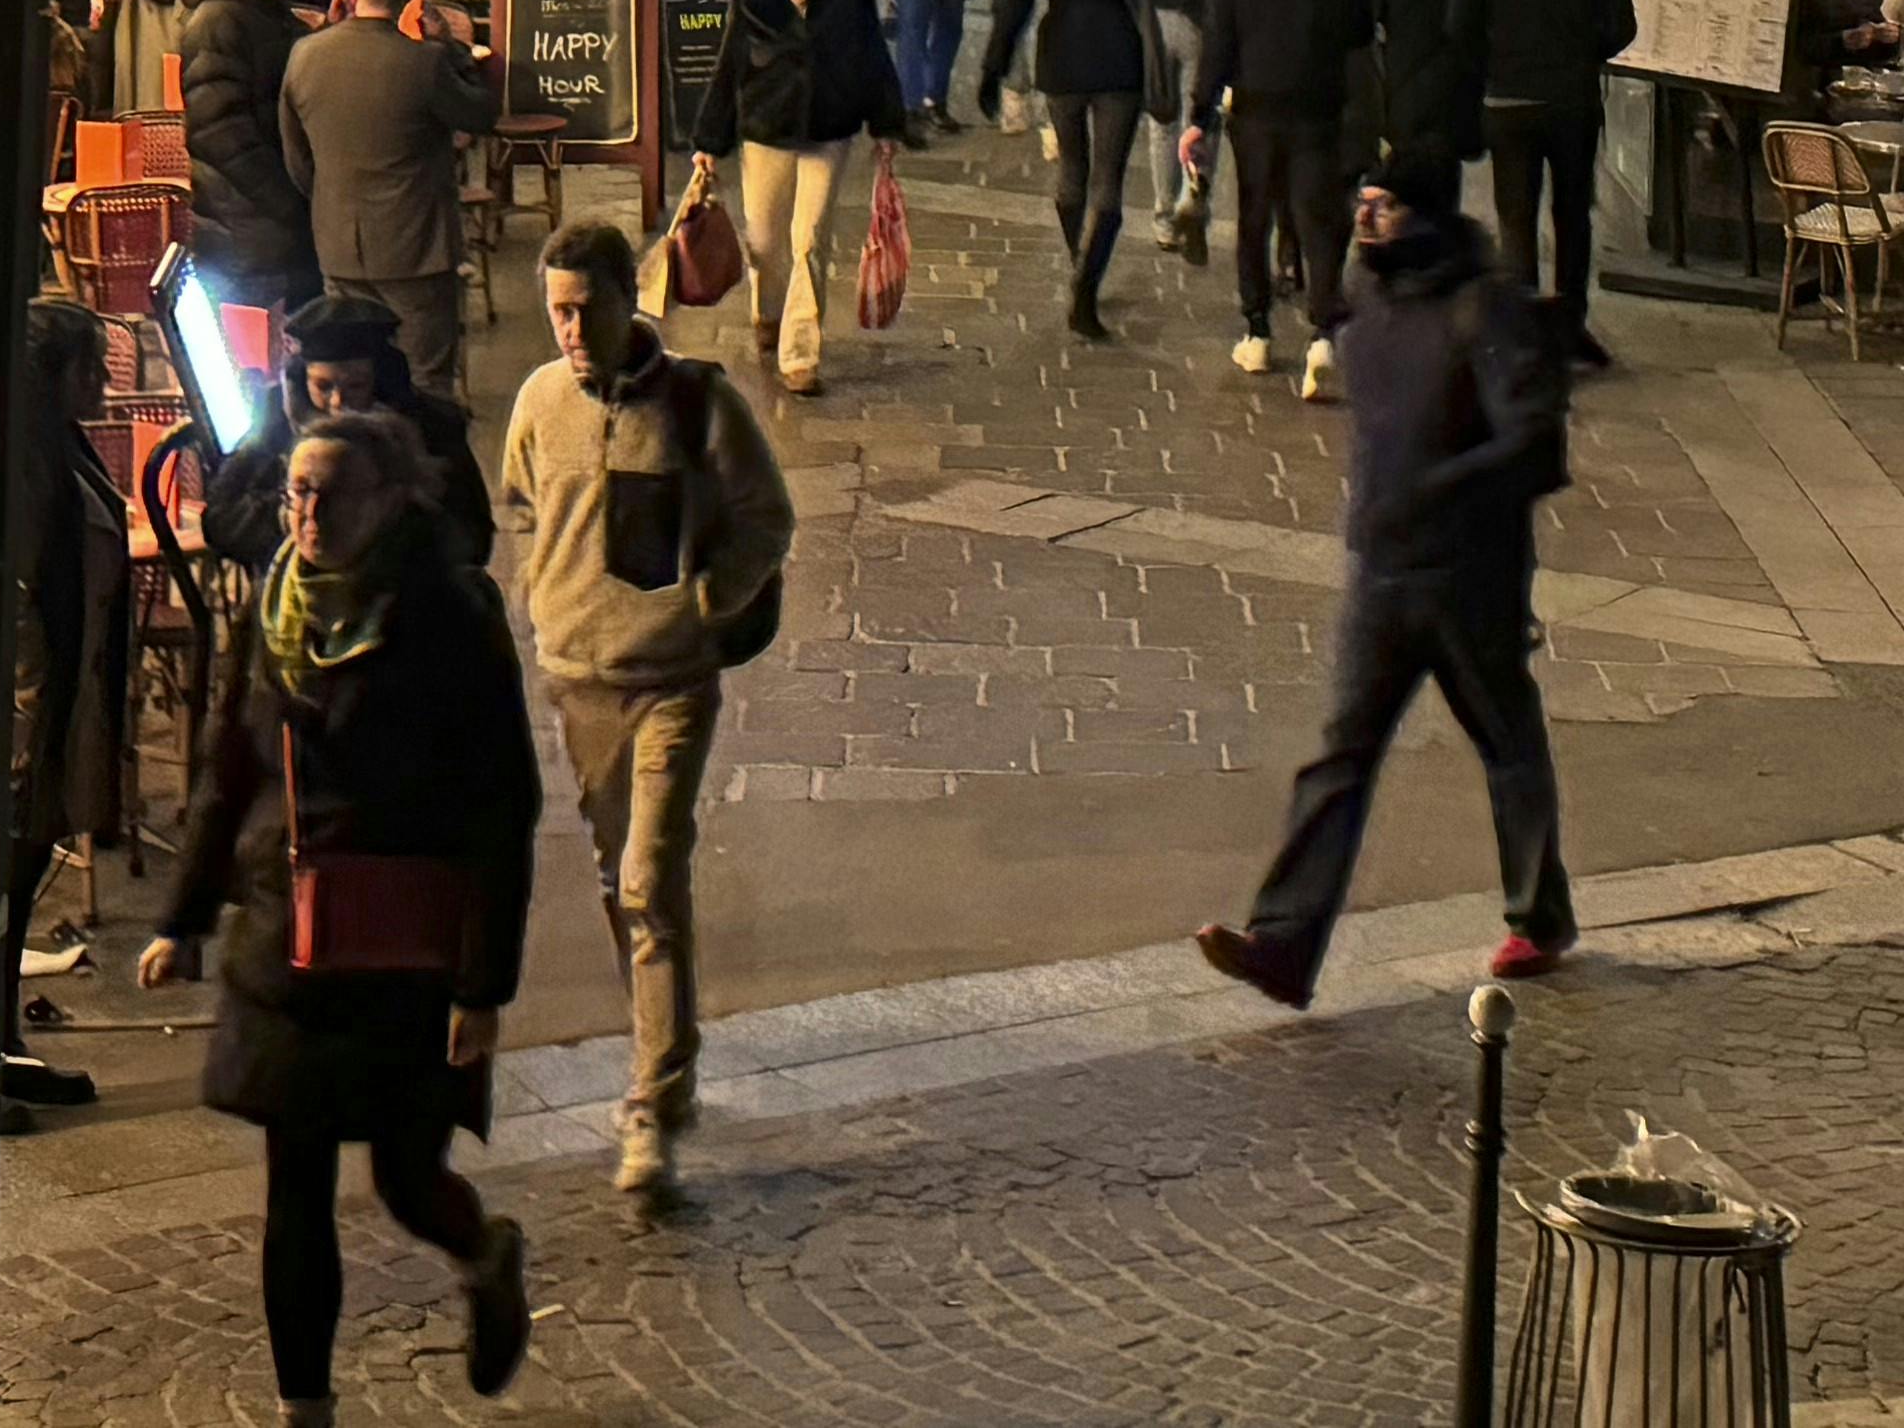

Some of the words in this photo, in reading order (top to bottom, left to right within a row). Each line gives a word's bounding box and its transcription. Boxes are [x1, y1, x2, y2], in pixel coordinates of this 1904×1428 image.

[679, 12, 723, 31] HAPPY
[533, 30, 618, 63] HAPPY
[538, 76, 605, 95] HOUR
